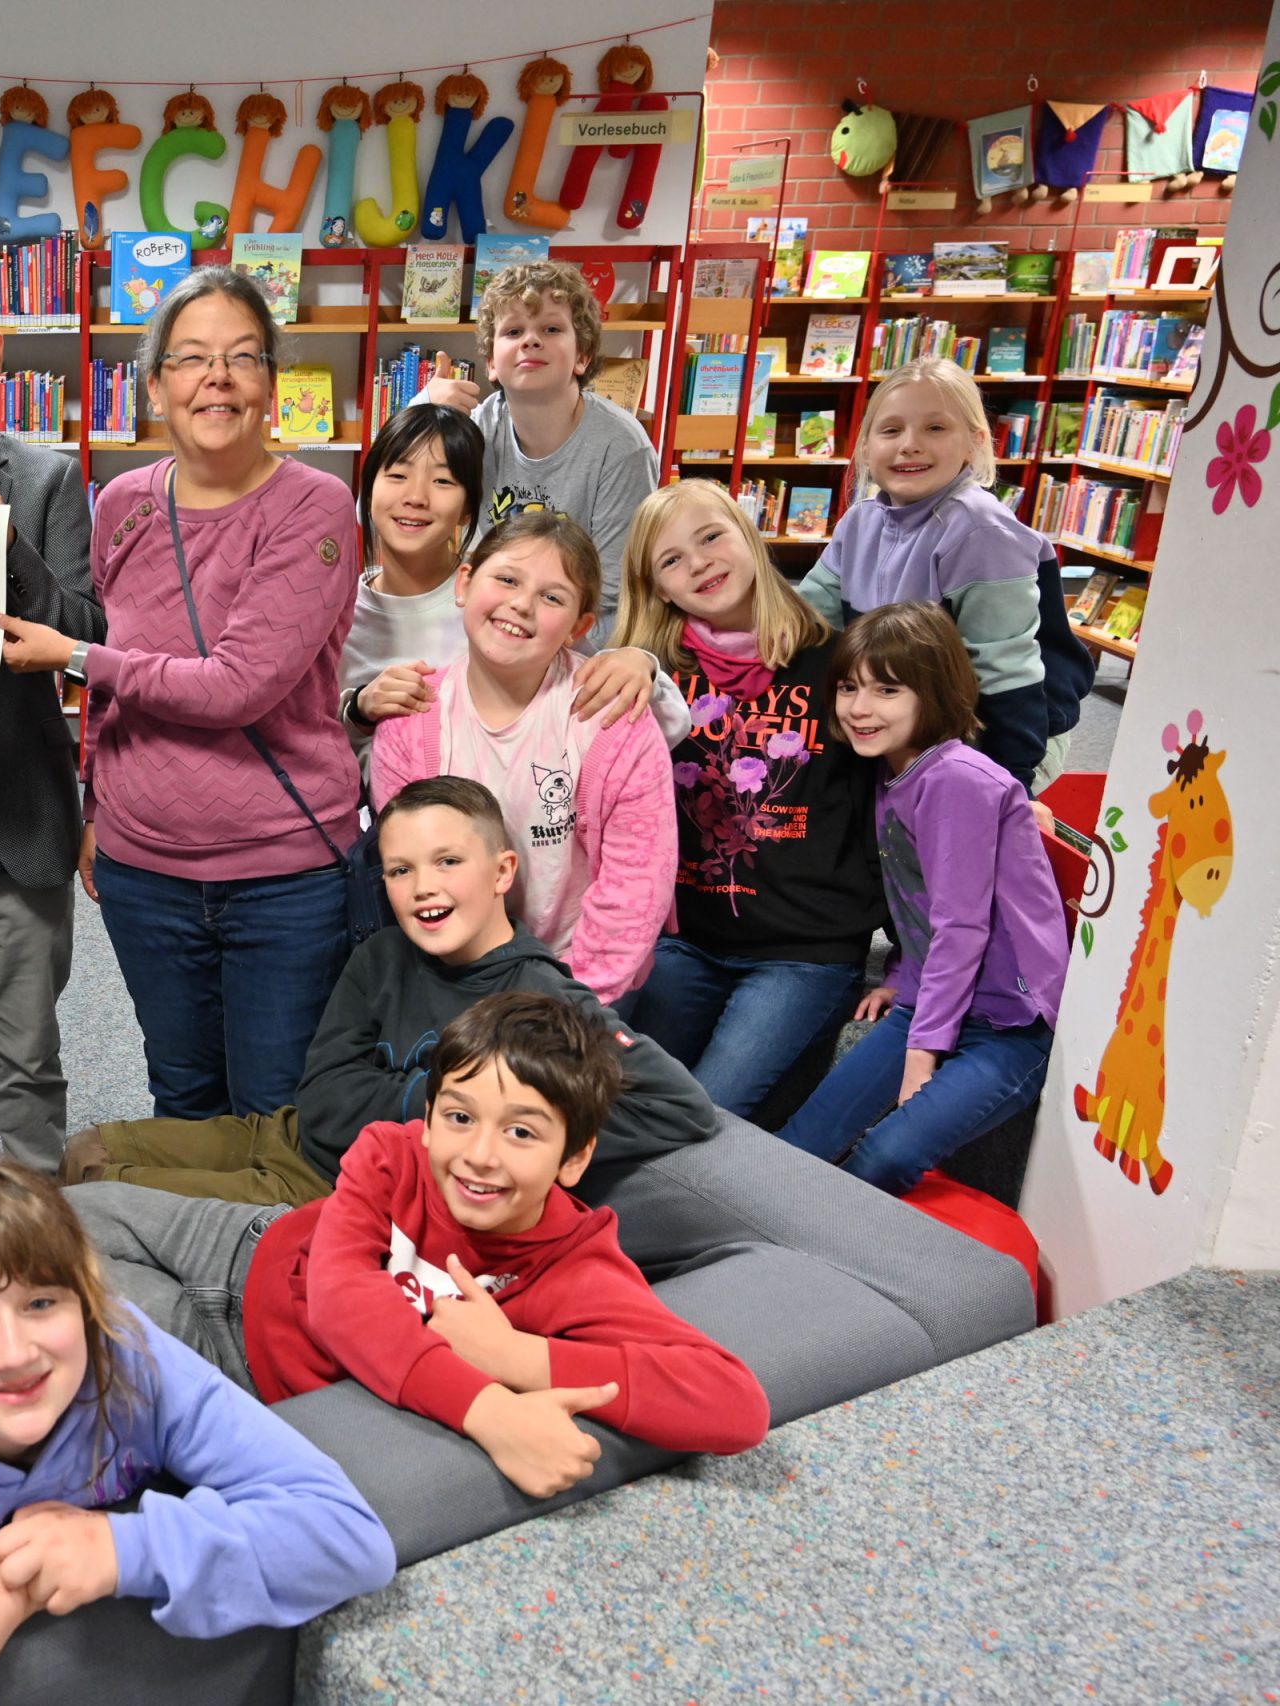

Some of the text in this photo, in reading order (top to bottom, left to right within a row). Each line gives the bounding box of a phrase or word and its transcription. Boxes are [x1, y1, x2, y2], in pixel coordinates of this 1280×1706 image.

[577, 121, 667, 138] Vorlesebuch
[70, 123, 141, 250] F
[139, 127, 229, 250] G
[354, 115, 419, 248] J
[420, 107, 515, 245] K
[503, 94, 571, 230] L
[136, 243, 184, 259] ROBERT!
[759, 803, 788, 814] SLOW
[754, 827, 807, 839] THE MOMENT
[716, 884, 757, 896] FOREVER
